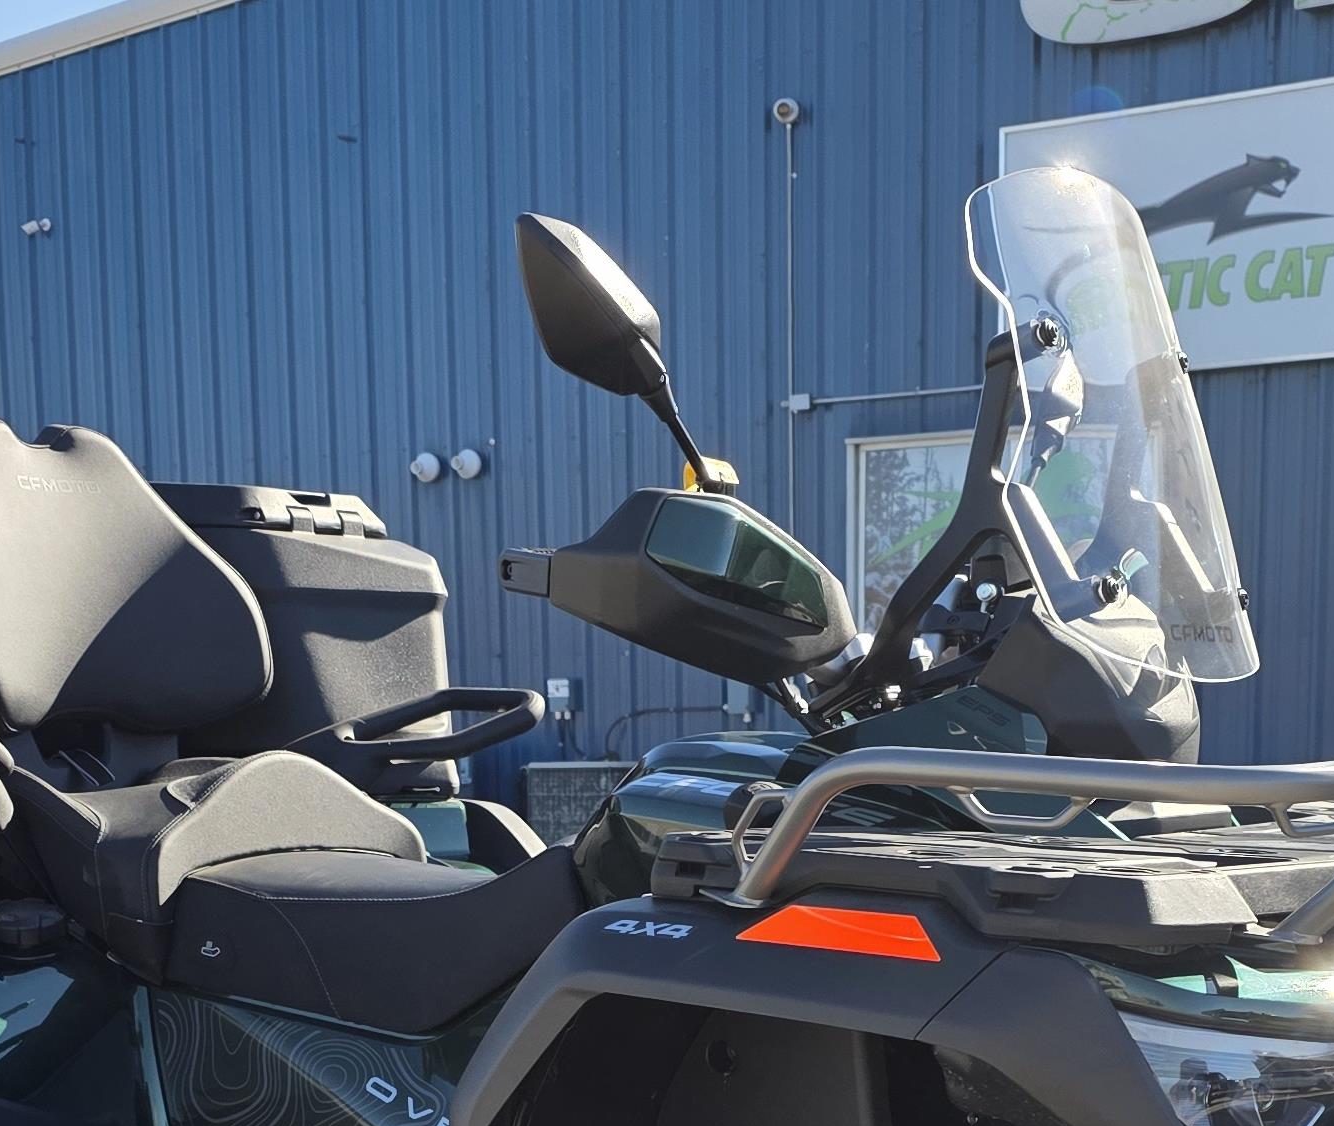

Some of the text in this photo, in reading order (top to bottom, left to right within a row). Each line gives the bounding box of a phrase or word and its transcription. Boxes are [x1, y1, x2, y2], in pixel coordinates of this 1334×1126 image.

[1157, 254, 1237, 312] TIC
[17, 474, 102, 494] CFMOTO
[1170, 624, 1234, 643] CFMOTO
